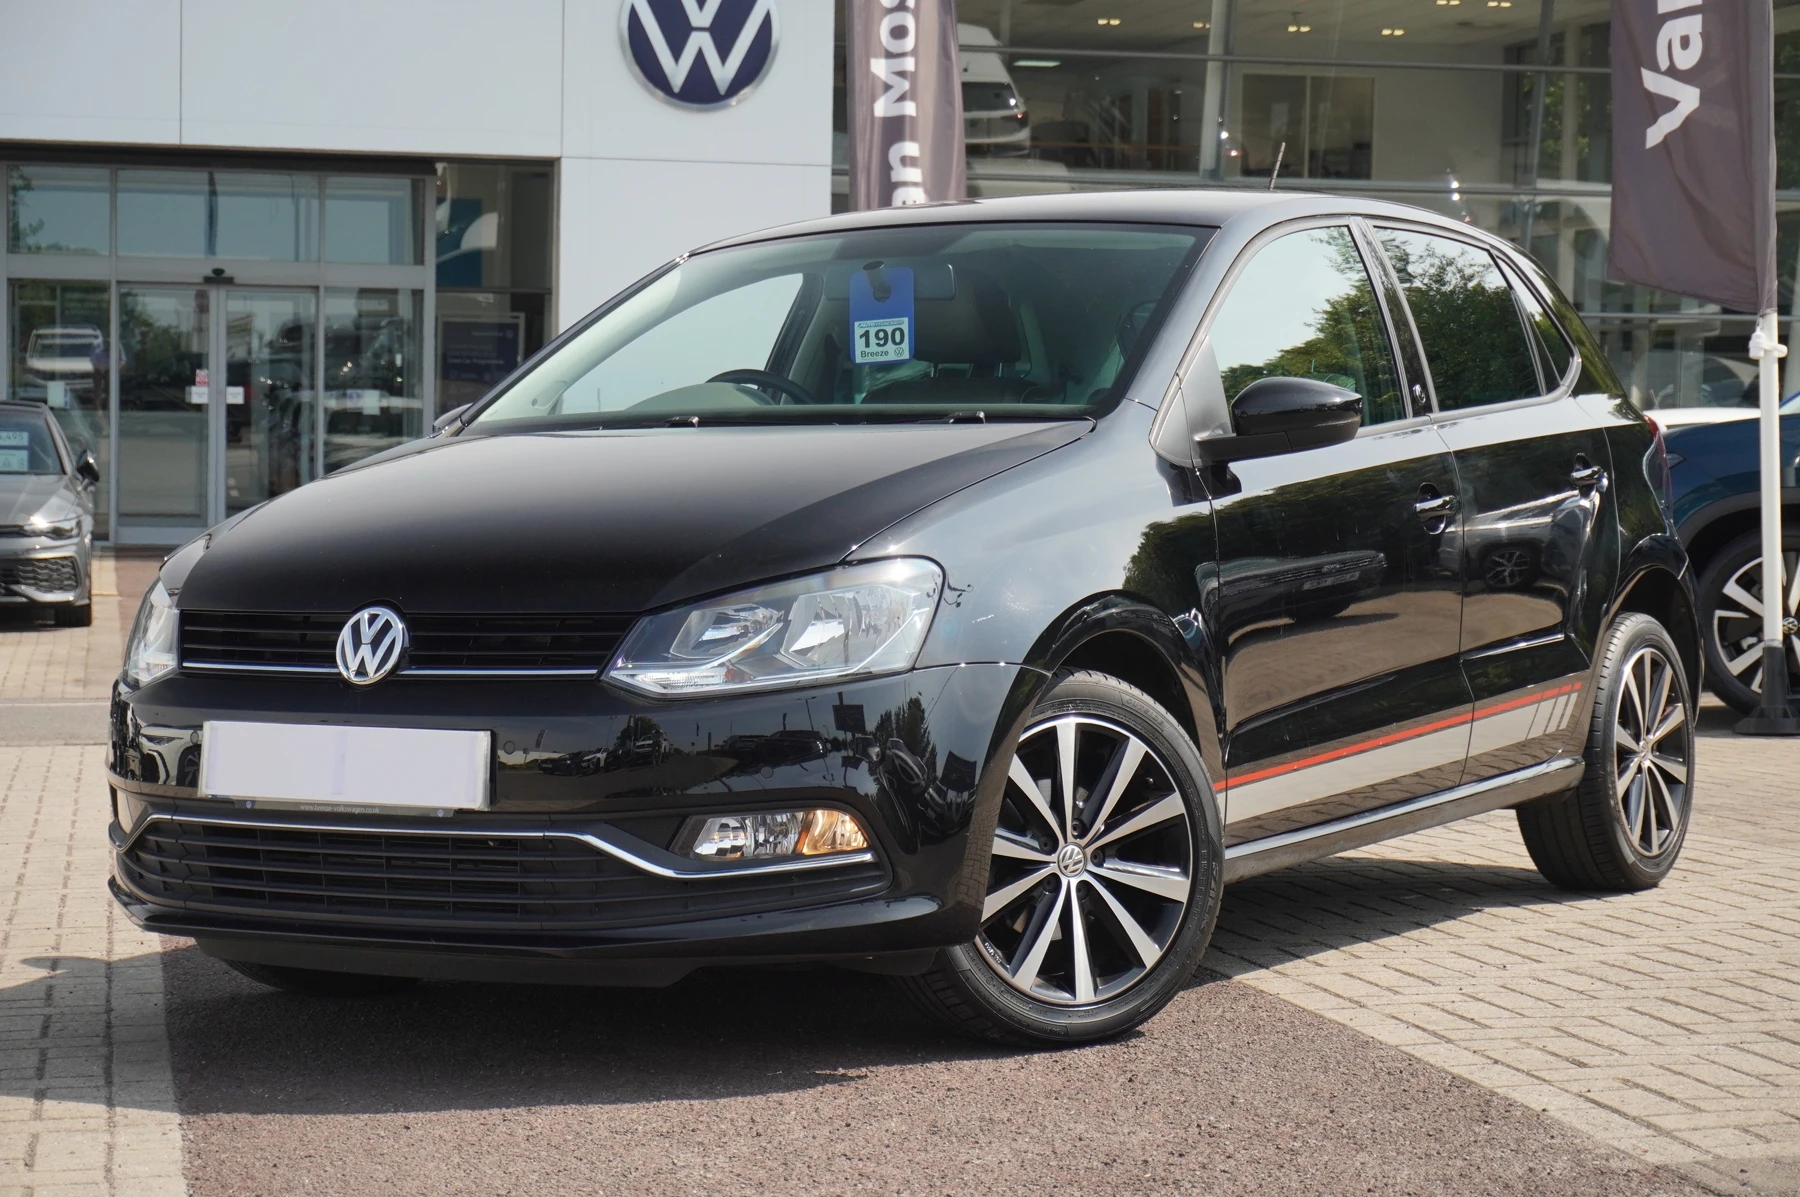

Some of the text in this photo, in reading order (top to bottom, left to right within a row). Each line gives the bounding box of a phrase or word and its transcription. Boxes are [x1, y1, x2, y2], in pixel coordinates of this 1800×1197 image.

[870, 0, 917, 117] Mo
[1641, 0, 1703, 149] Va
[859, 327, 905, 348] 190
[860, 350, 889, 358] Breeze
